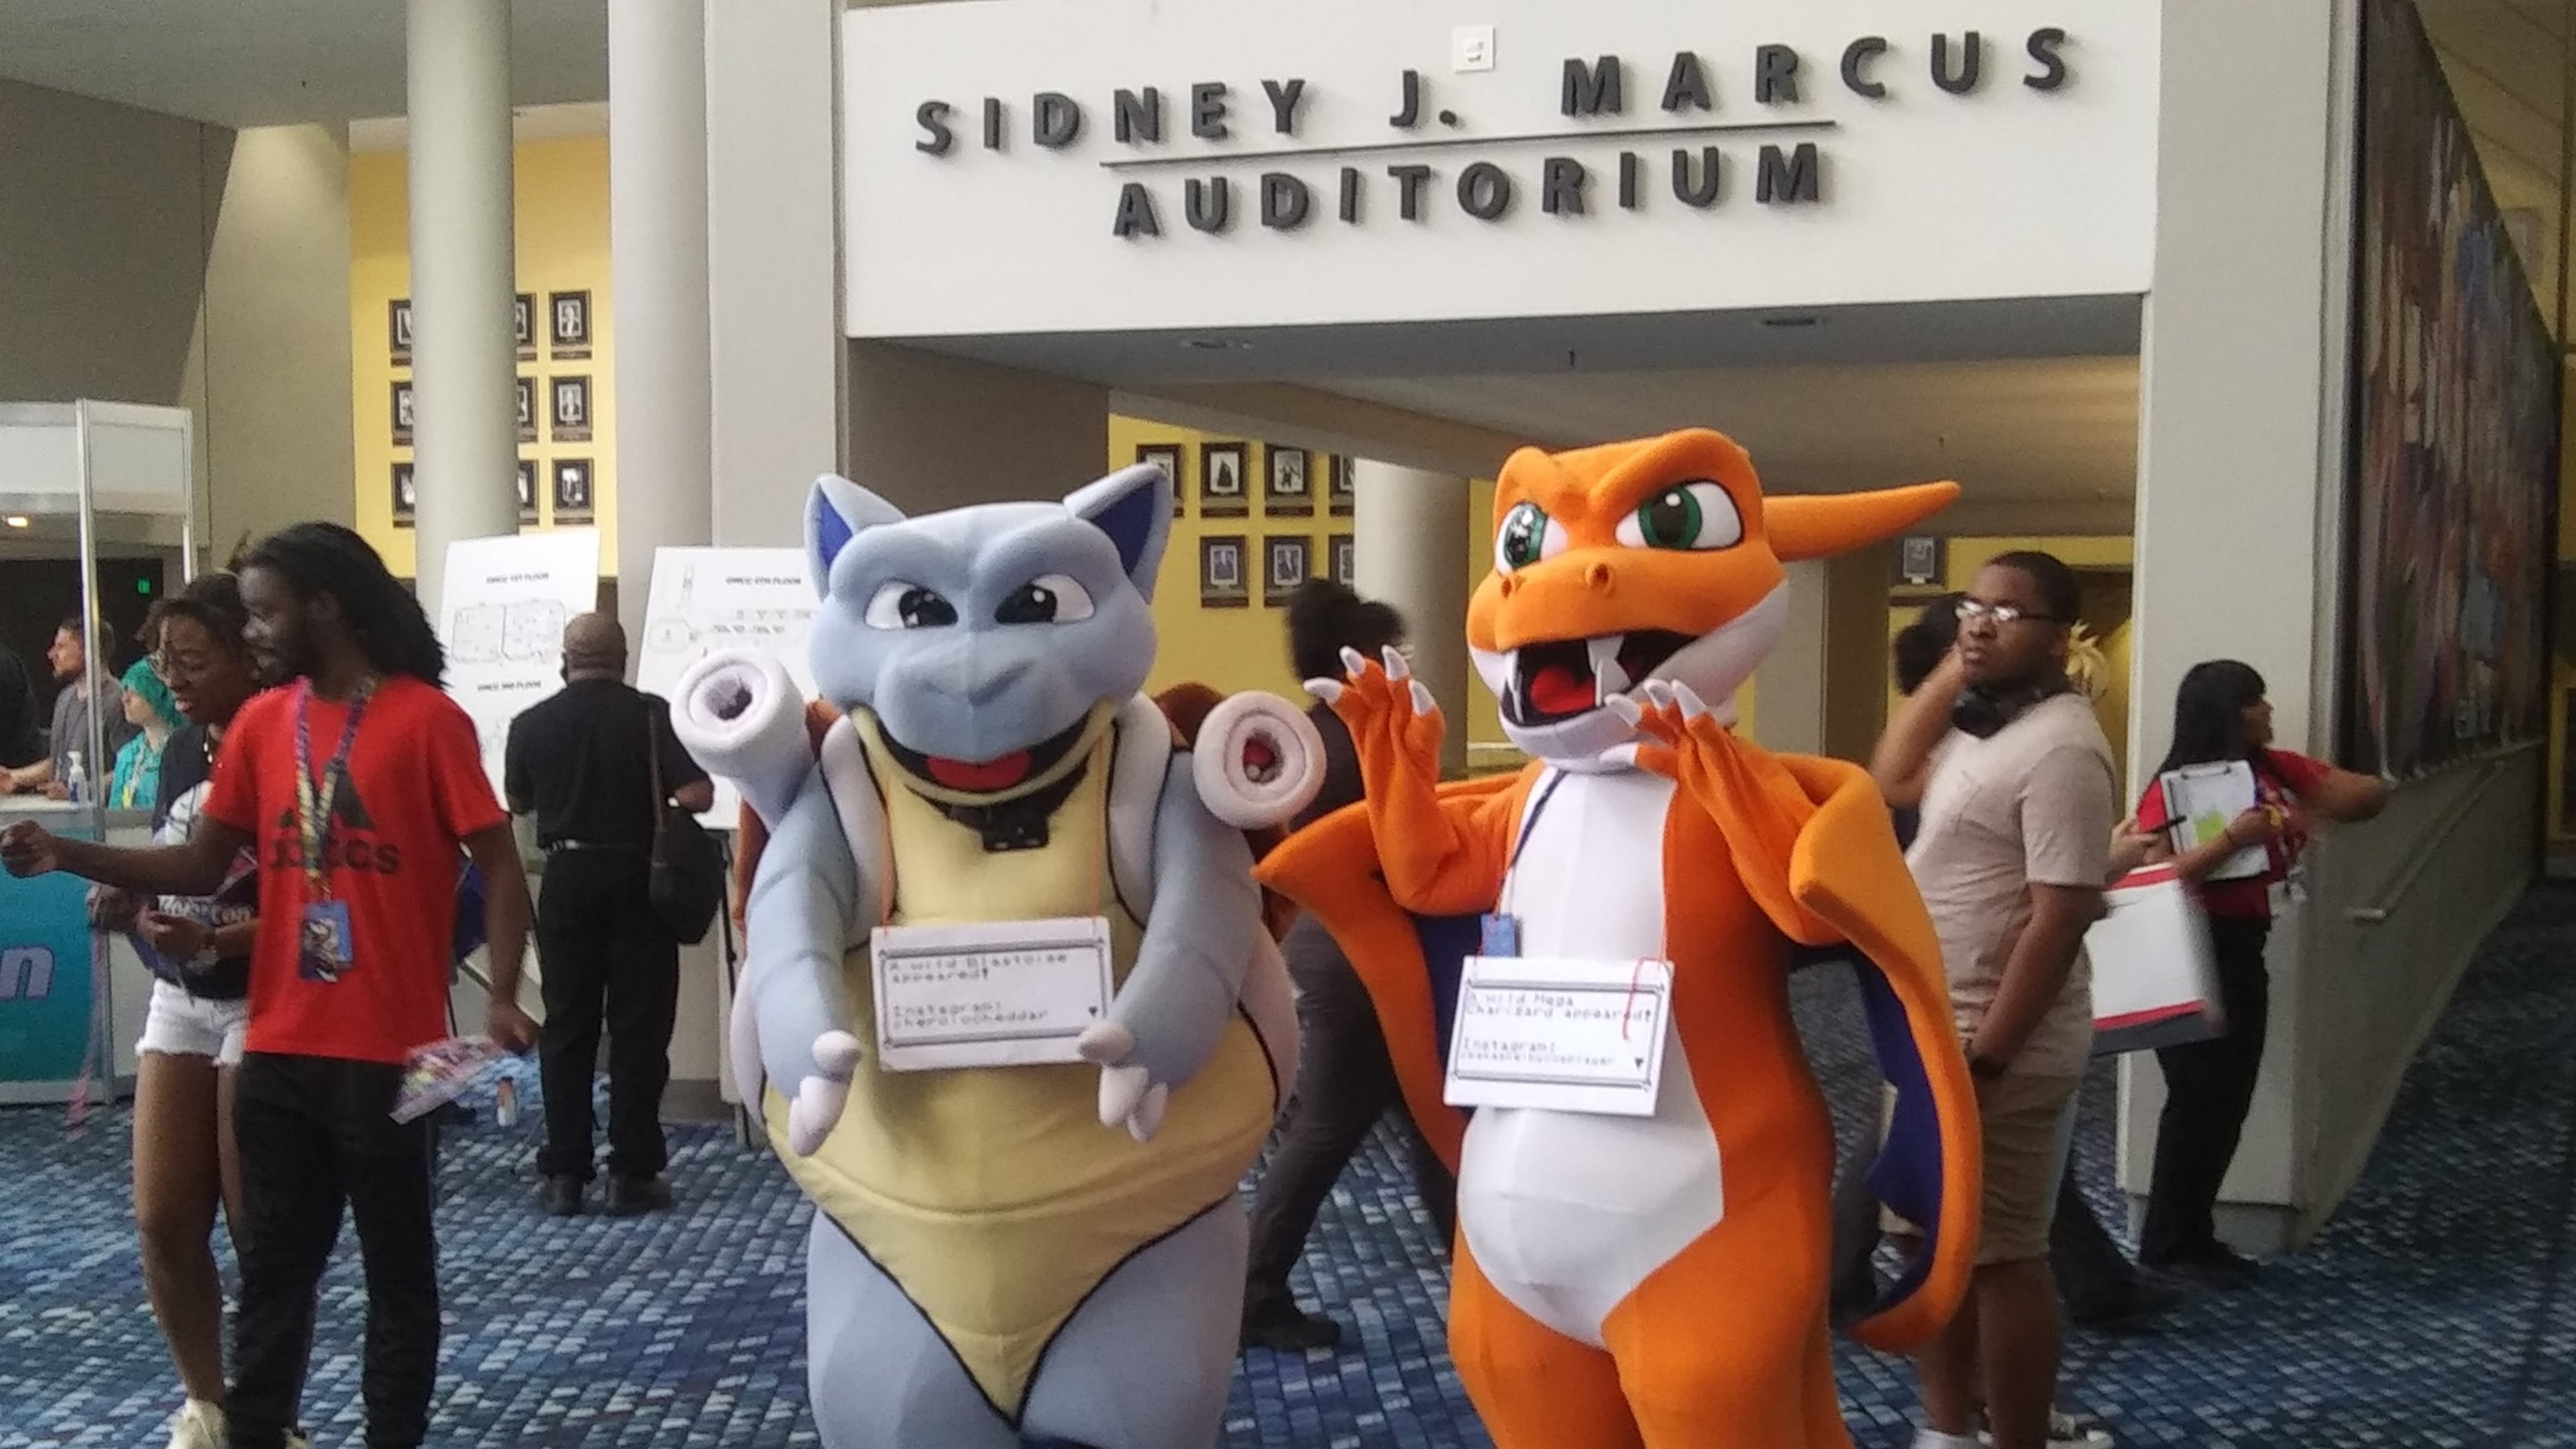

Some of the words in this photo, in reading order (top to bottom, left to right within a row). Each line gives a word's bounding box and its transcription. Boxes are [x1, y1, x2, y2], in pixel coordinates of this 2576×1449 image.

[916, 78, 1307, 158] SIDNEY
[1389, 69, 1457, 127] J.
[1560, 27, 2066, 117] MARCUS
[1112, 142, 1819, 237] AUDITORIUM
[910, 958, 957, 971] wild
[966, 953, 1068, 969] Blastoise
[892, 967, 989, 984] appeared!
[1485, 993, 1526, 1005] wild
[1534, 994, 1574, 1007] Mega
[1466, 1005, 1554, 1018] Charizard
